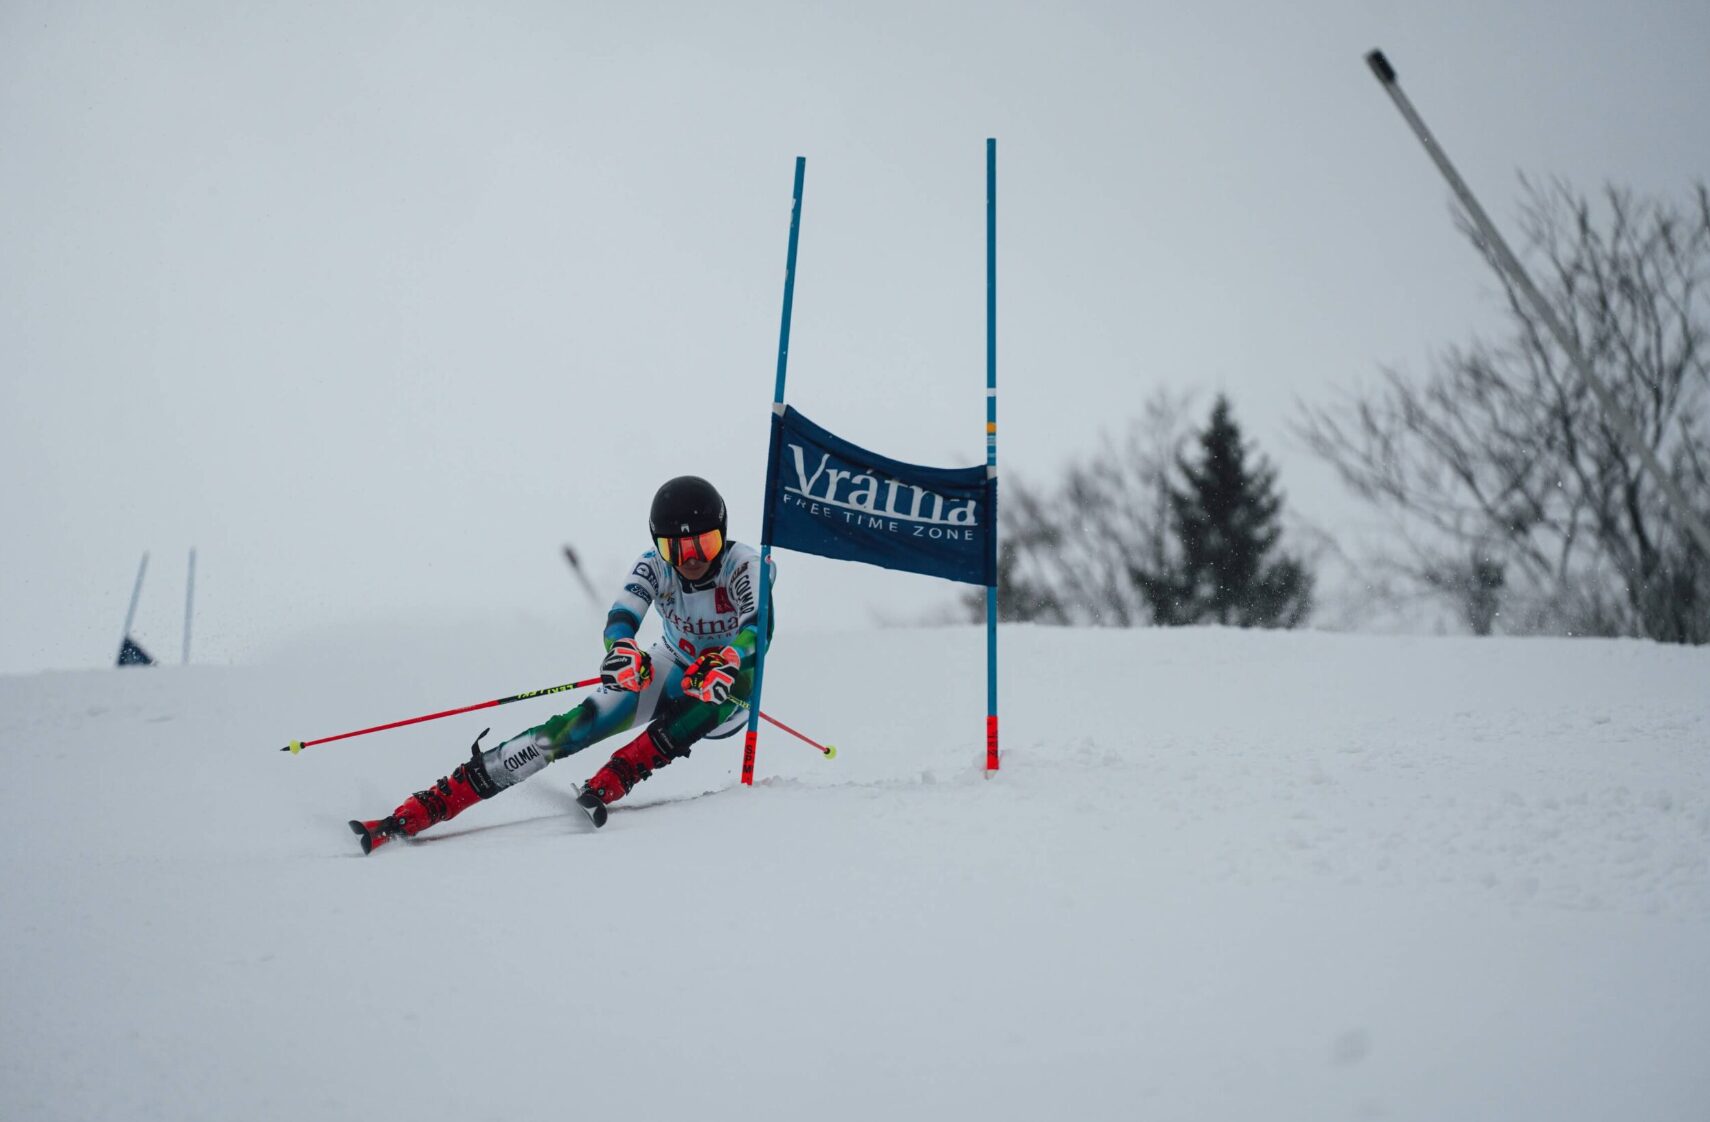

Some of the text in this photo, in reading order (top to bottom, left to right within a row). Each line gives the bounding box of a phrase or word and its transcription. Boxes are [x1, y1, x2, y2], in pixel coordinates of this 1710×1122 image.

[787, 443, 977, 524] Vrátna
[783, 493, 974, 541] FREE TIME ZONE
